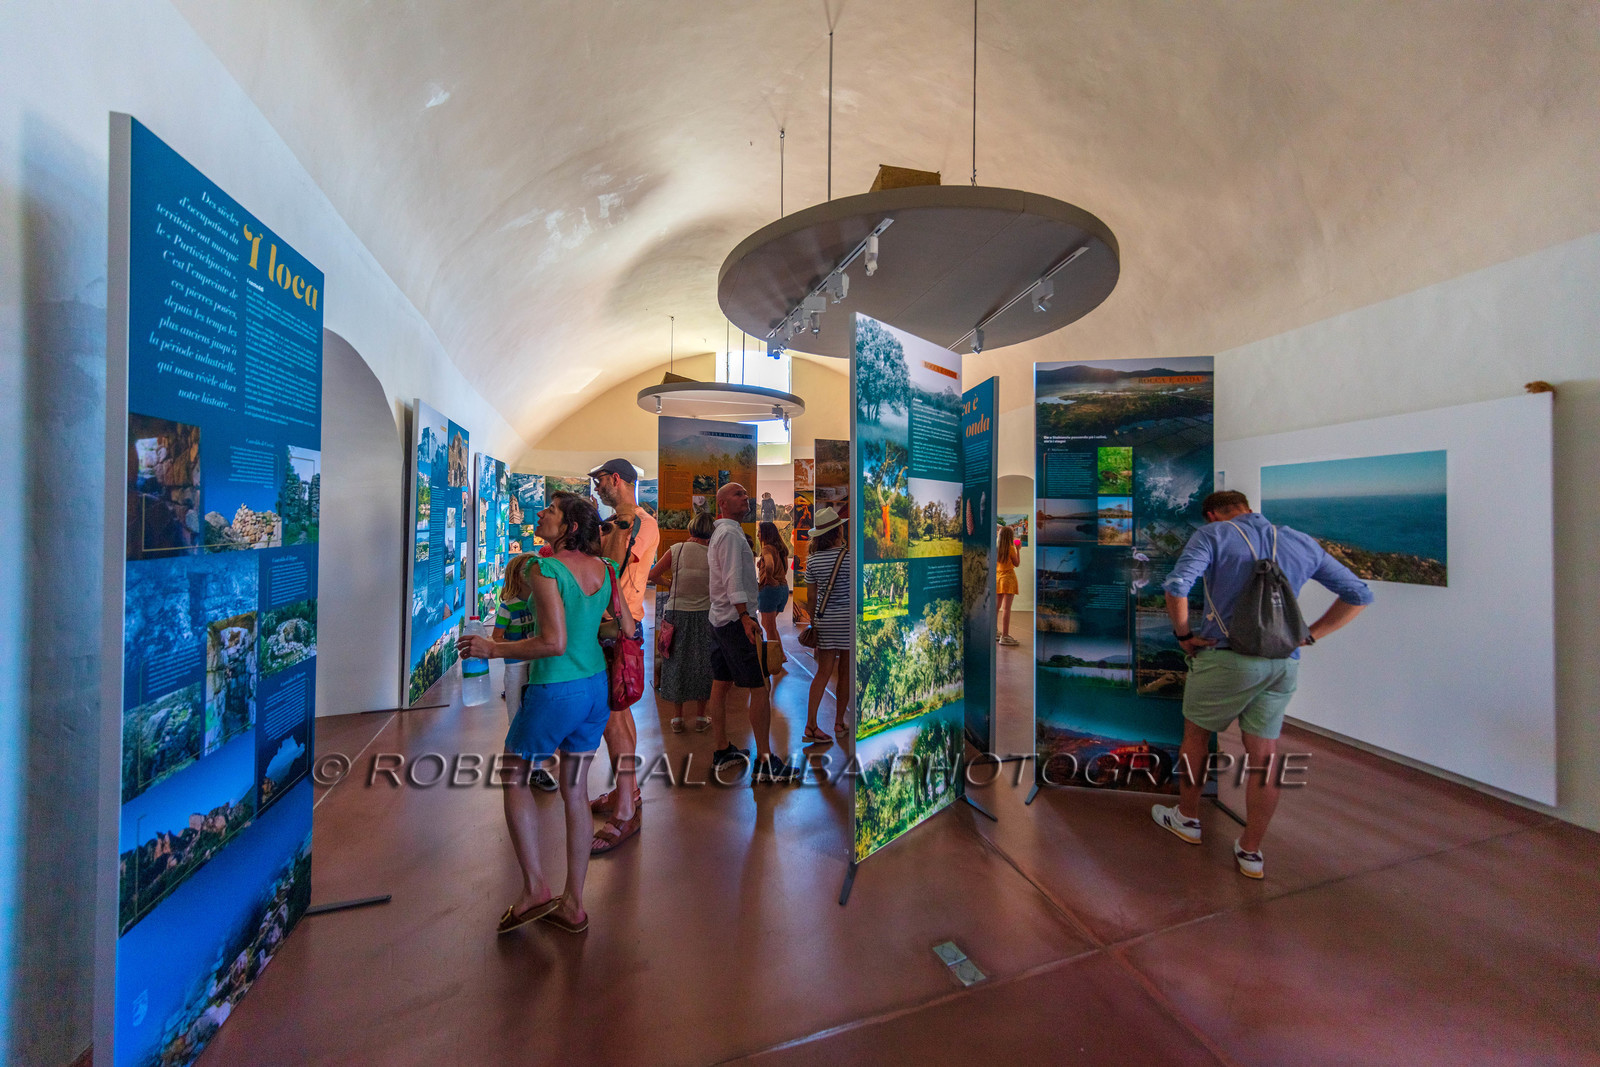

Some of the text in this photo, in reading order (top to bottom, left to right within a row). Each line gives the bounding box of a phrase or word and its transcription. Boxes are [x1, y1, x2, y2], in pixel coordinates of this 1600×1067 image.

[202, 191, 240, 227] Des siècles
[156, 223, 166, 236] le
[156, 204, 239, 262] territoire ont marqué
[229, 232, 239, 245] du
[268, 243, 318, 311] loca
[171, 280, 238, 320] ces pierres posées,
[229, 289, 239, 300] de
[158, 316, 179, 331] plus
[180, 328, 211, 345] anciens
[164, 295, 238, 338] depuis les temps les
[149, 331, 238, 376] la période industrielle,
[157, 361, 237, 393] qui nous révèle alors
[178, 389, 201, 401] notre
[965, 413, 990, 438] onda
